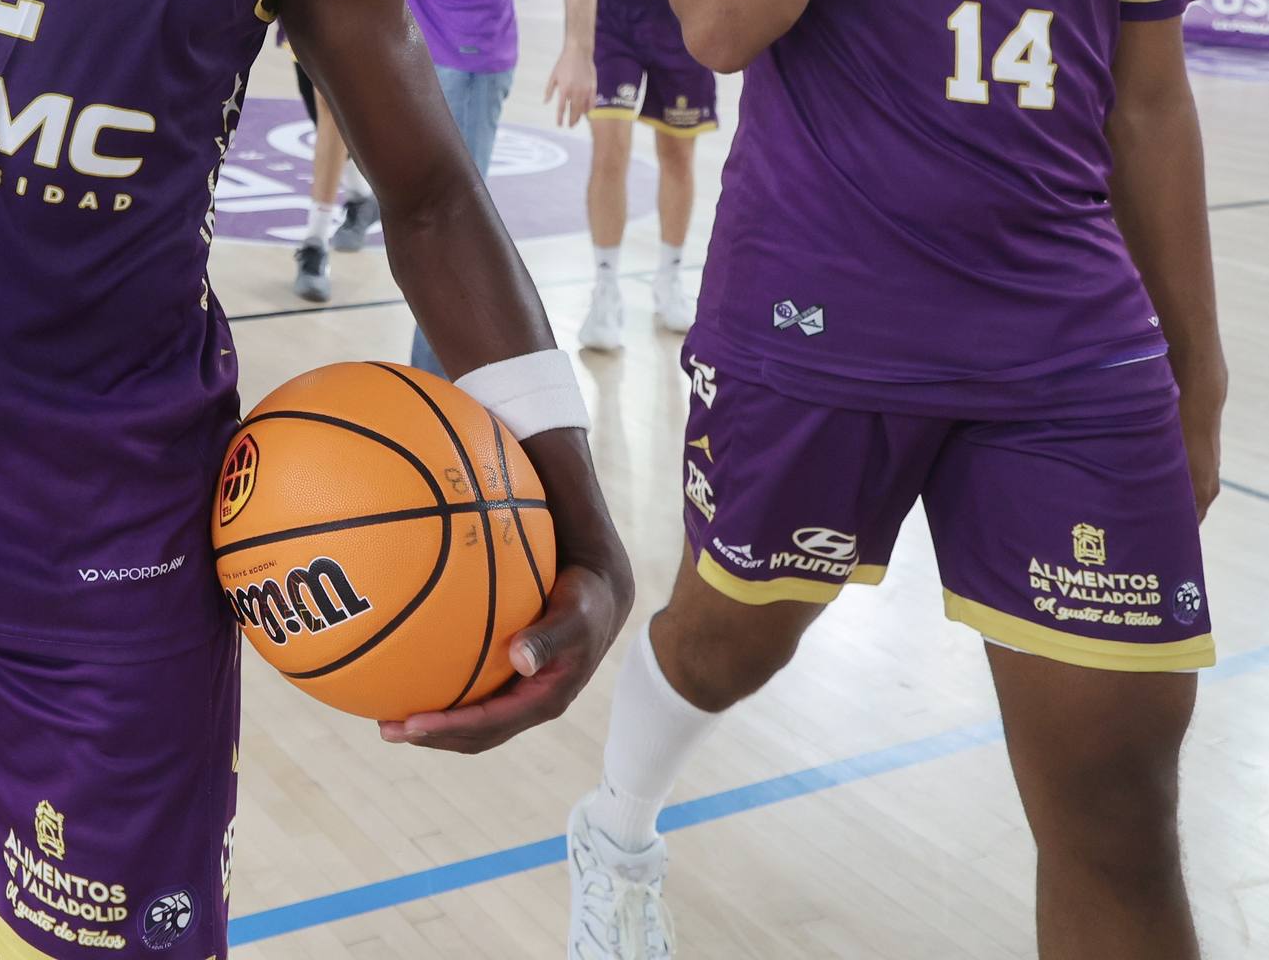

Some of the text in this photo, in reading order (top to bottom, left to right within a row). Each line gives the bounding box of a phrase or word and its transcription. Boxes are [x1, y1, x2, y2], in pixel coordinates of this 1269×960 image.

[945, 1, 1059, 110] 14
[100, 555, 185, 581] VAPORDRAW
[713, 537, 765, 568] MERCURY
[770, 552, 859, 577] HYUNDA
[1028, 557, 1160, 590] ALIMENTOS
[224, 555, 374, 647] Wils
[1030, 575, 1162, 606] DE VALLADOLID
[1055, 605, 1103, 623] gusto
[1102, 610, 1124, 625] de
[1123, 611, 1162, 627] todos
[4, 828, 127, 904] ALIMENTOS
[3, 851, 128, 923] DE VALLADOLID
[14, 902, 57, 933] gusto
[53, 922, 77, 944] de
[77, 928, 126, 950] todos
